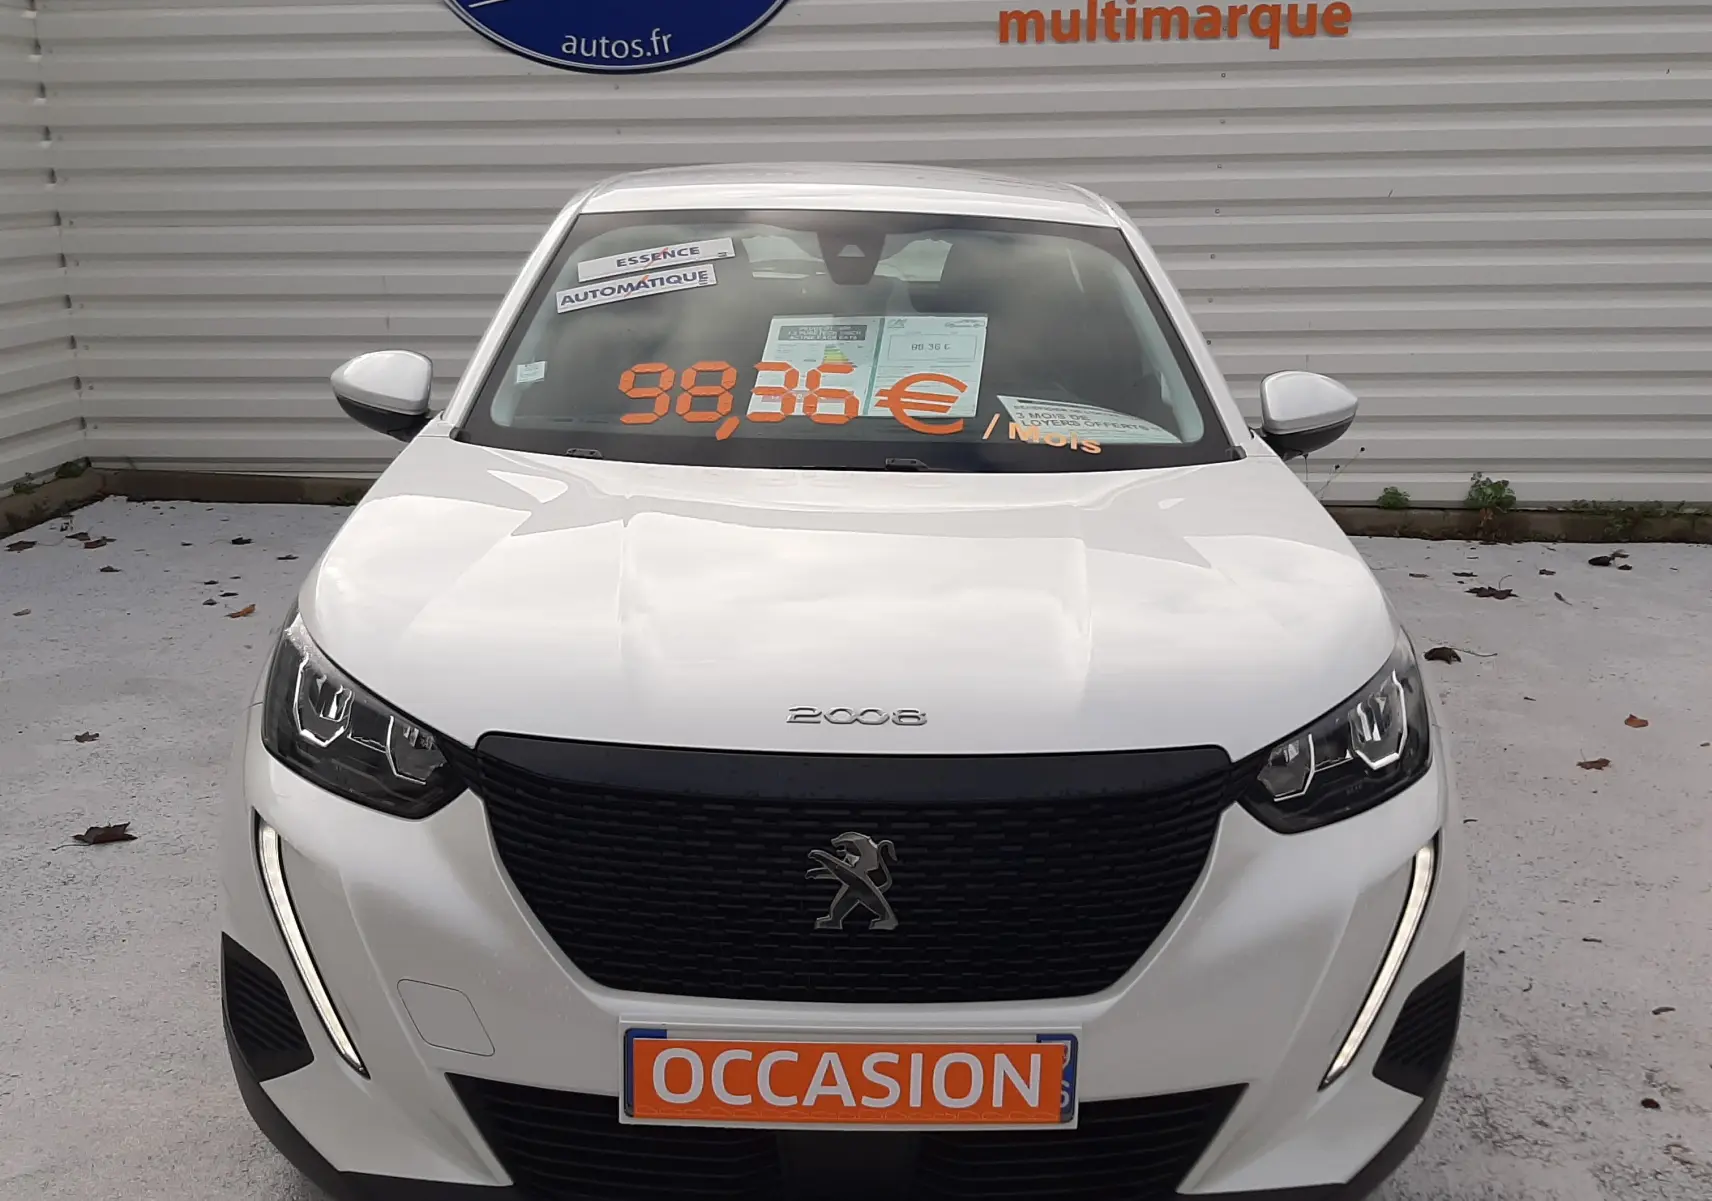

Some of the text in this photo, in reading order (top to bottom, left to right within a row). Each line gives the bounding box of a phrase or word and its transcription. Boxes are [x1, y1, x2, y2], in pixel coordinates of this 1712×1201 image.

[998, 0, 1353, 50] multimarque
[561, 28, 673, 59] autos.fr
[616, 246, 700, 268] ESSENCE
[560, 270, 709, 306] AUTOMATIQUE
[1008, 421, 1102, 454] Mois
[1021, 419, 1081, 428] LOYERS
[786, 705, 928, 727] 2008
[651, 1047, 1042, 1109] OCCASION
